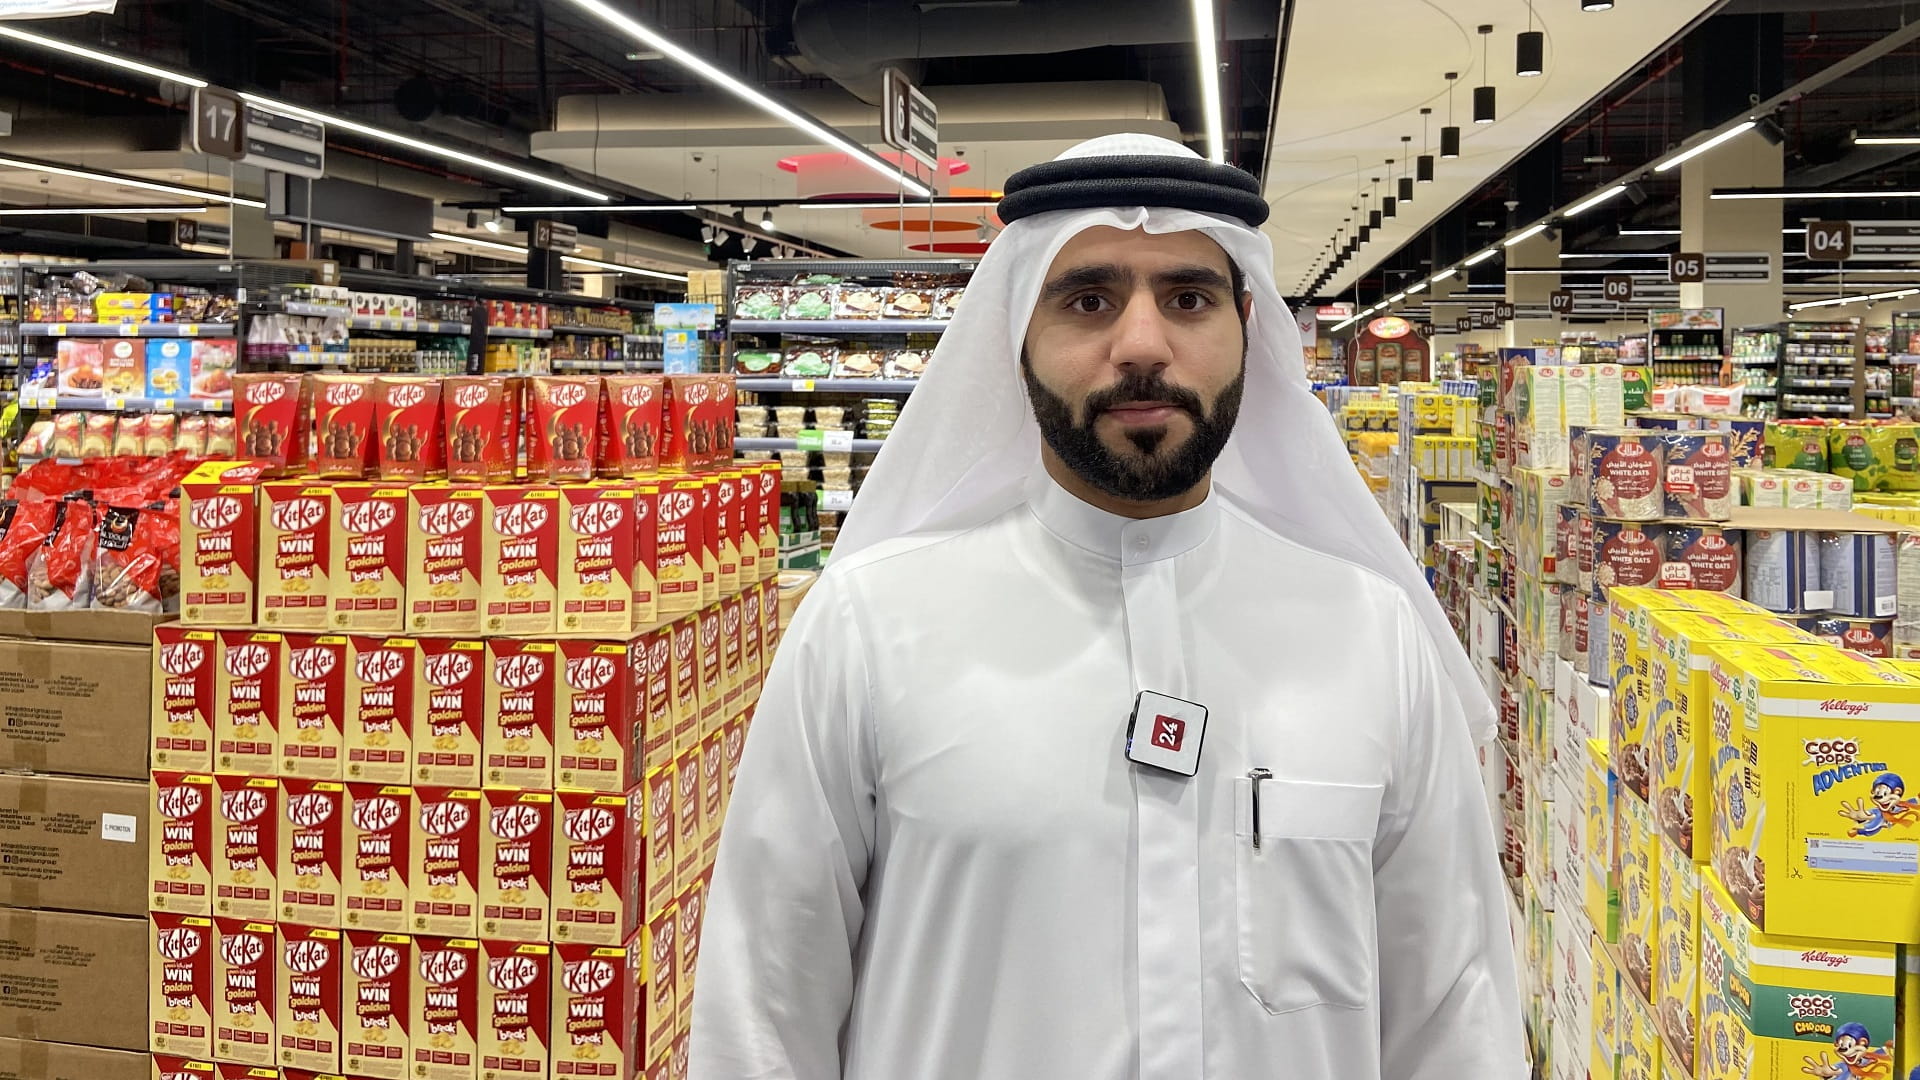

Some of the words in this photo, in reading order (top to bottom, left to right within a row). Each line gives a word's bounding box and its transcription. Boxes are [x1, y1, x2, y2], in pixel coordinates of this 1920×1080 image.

[206, 105, 236, 142] 17
[181, 224, 193, 239] 24
[540, 227, 550, 242] 21
[1814, 230, 1844, 250] 04
[1674, 260, 1699, 276] 05
[1607, 282, 1628, 296] 06
[1553, 295, 1570, 308] 07
[1483, 314, 1495, 324] 09
[1497, 307, 1511, 317] 08
[1424, 326, 1434, 334] 11
[1459, 320, 1470, 330] 10
[197, 496, 238, 528] KitKat
[279, 498, 321, 530] KitKat
[349, 500, 391, 532] KitKat
[427, 501, 470, 534] KitKat
[501, 502, 544, 535] KitKat
[577, 501, 619, 534] KitKat
[658, 530, 685, 542] WIN
[199, 537, 231, 551] WIN
[280, 540, 313, 553] WIN
[350, 542, 383, 555] WIN
[428, 543, 462, 557] WIN
[579, 543, 611, 557] WIN
[658, 543, 686, 554] olden
[197, 551, 232, 565] golden
[503, 544, 536, 559] WIN
[278, 554, 314, 567] golden
[348, 556, 384, 570] golden
[426, 558, 463, 572] golden
[500, 559, 537, 573] golden
[577, 558, 612, 571] golden
[203, 565, 229, 576] break
[284, 567, 311, 578] break
[354, 570, 381, 581] break
[432, 572, 460, 583] break
[583, 572, 609, 583] break
[507, 573, 534, 584] break
[166, 643, 201, 673] KitKat
[231, 645, 266, 675] KitKat
[295, 647, 332, 678] KitKat
[362, 650, 401, 681] KitKat
[430, 653, 468, 684] KitKat
[501, 655, 540, 687] KitKat
[572, 657, 611, 688] KitKat
[167, 684, 194, 696] WIN
[232, 686, 259, 699] WIN
[297, 689, 324, 702] WIN
[363, 693, 393, 705] WIN
[432, 696, 461, 709] WIN
[502, 698, 532, 711] WIN
[574, 700, 603, 713] WIN
[1820, 699, 1870, 715] Kellogg's
[361, 708, 393, 720] golden
[429, 711, 462, 723] golden
[500, 713, 533, 725] golden
[572, 715, 604, 727] golden
[366, 721, 391, 732] break
[435, 725, 459, 735] break
[506, 727, 531, 737] break
[577, 729, 602, 739] break
[1160, 722, 1178, 746] 24
[163, 786, 199, 816] KitKat
[227, 790, 263, 820] KitKat
[293, 794, 329, 825] KitKat
[359, 798, 397, 829] KitKat
[427, 802, 466, 833] KitKat
[497, 806, 536, 837] KitKat
[570, 808, 611, 840] KitKat
[165, 827, 192, 840] WIN
[229, 831, 257, 844] WIN
[295, 836, 322, 849] WIN
[360, 841, 389, 853] WIN
[428, 845, 458, 858] WIN
[498, 849, 529, 862] WIN
[571, 852, 602, 865] WIN
[163, 928, 198, 959] KitKat
[226, 933, 261, 965] KitKat
[290, 940, 325, 972] KitKat
[358, 946, 396, 977] KitKat
[1801, 950, 1850, 967] Kellogg's
[426, 950, 463, 983] KitKat
[494, 956, 534, 989] KitKat
[165, 969, 191, 982] WIN
[228, 975, 255, 988] WIN
[569, 960, 610, 992] KitKat
[292, 982, 319, 996] WIN
[360, 988, 389, 1001] WIN
[427, 993, 456, 1007] WIN
[496, 1000, 527, 1013] WIN
[571, 1004, 602, 1017] WIN
